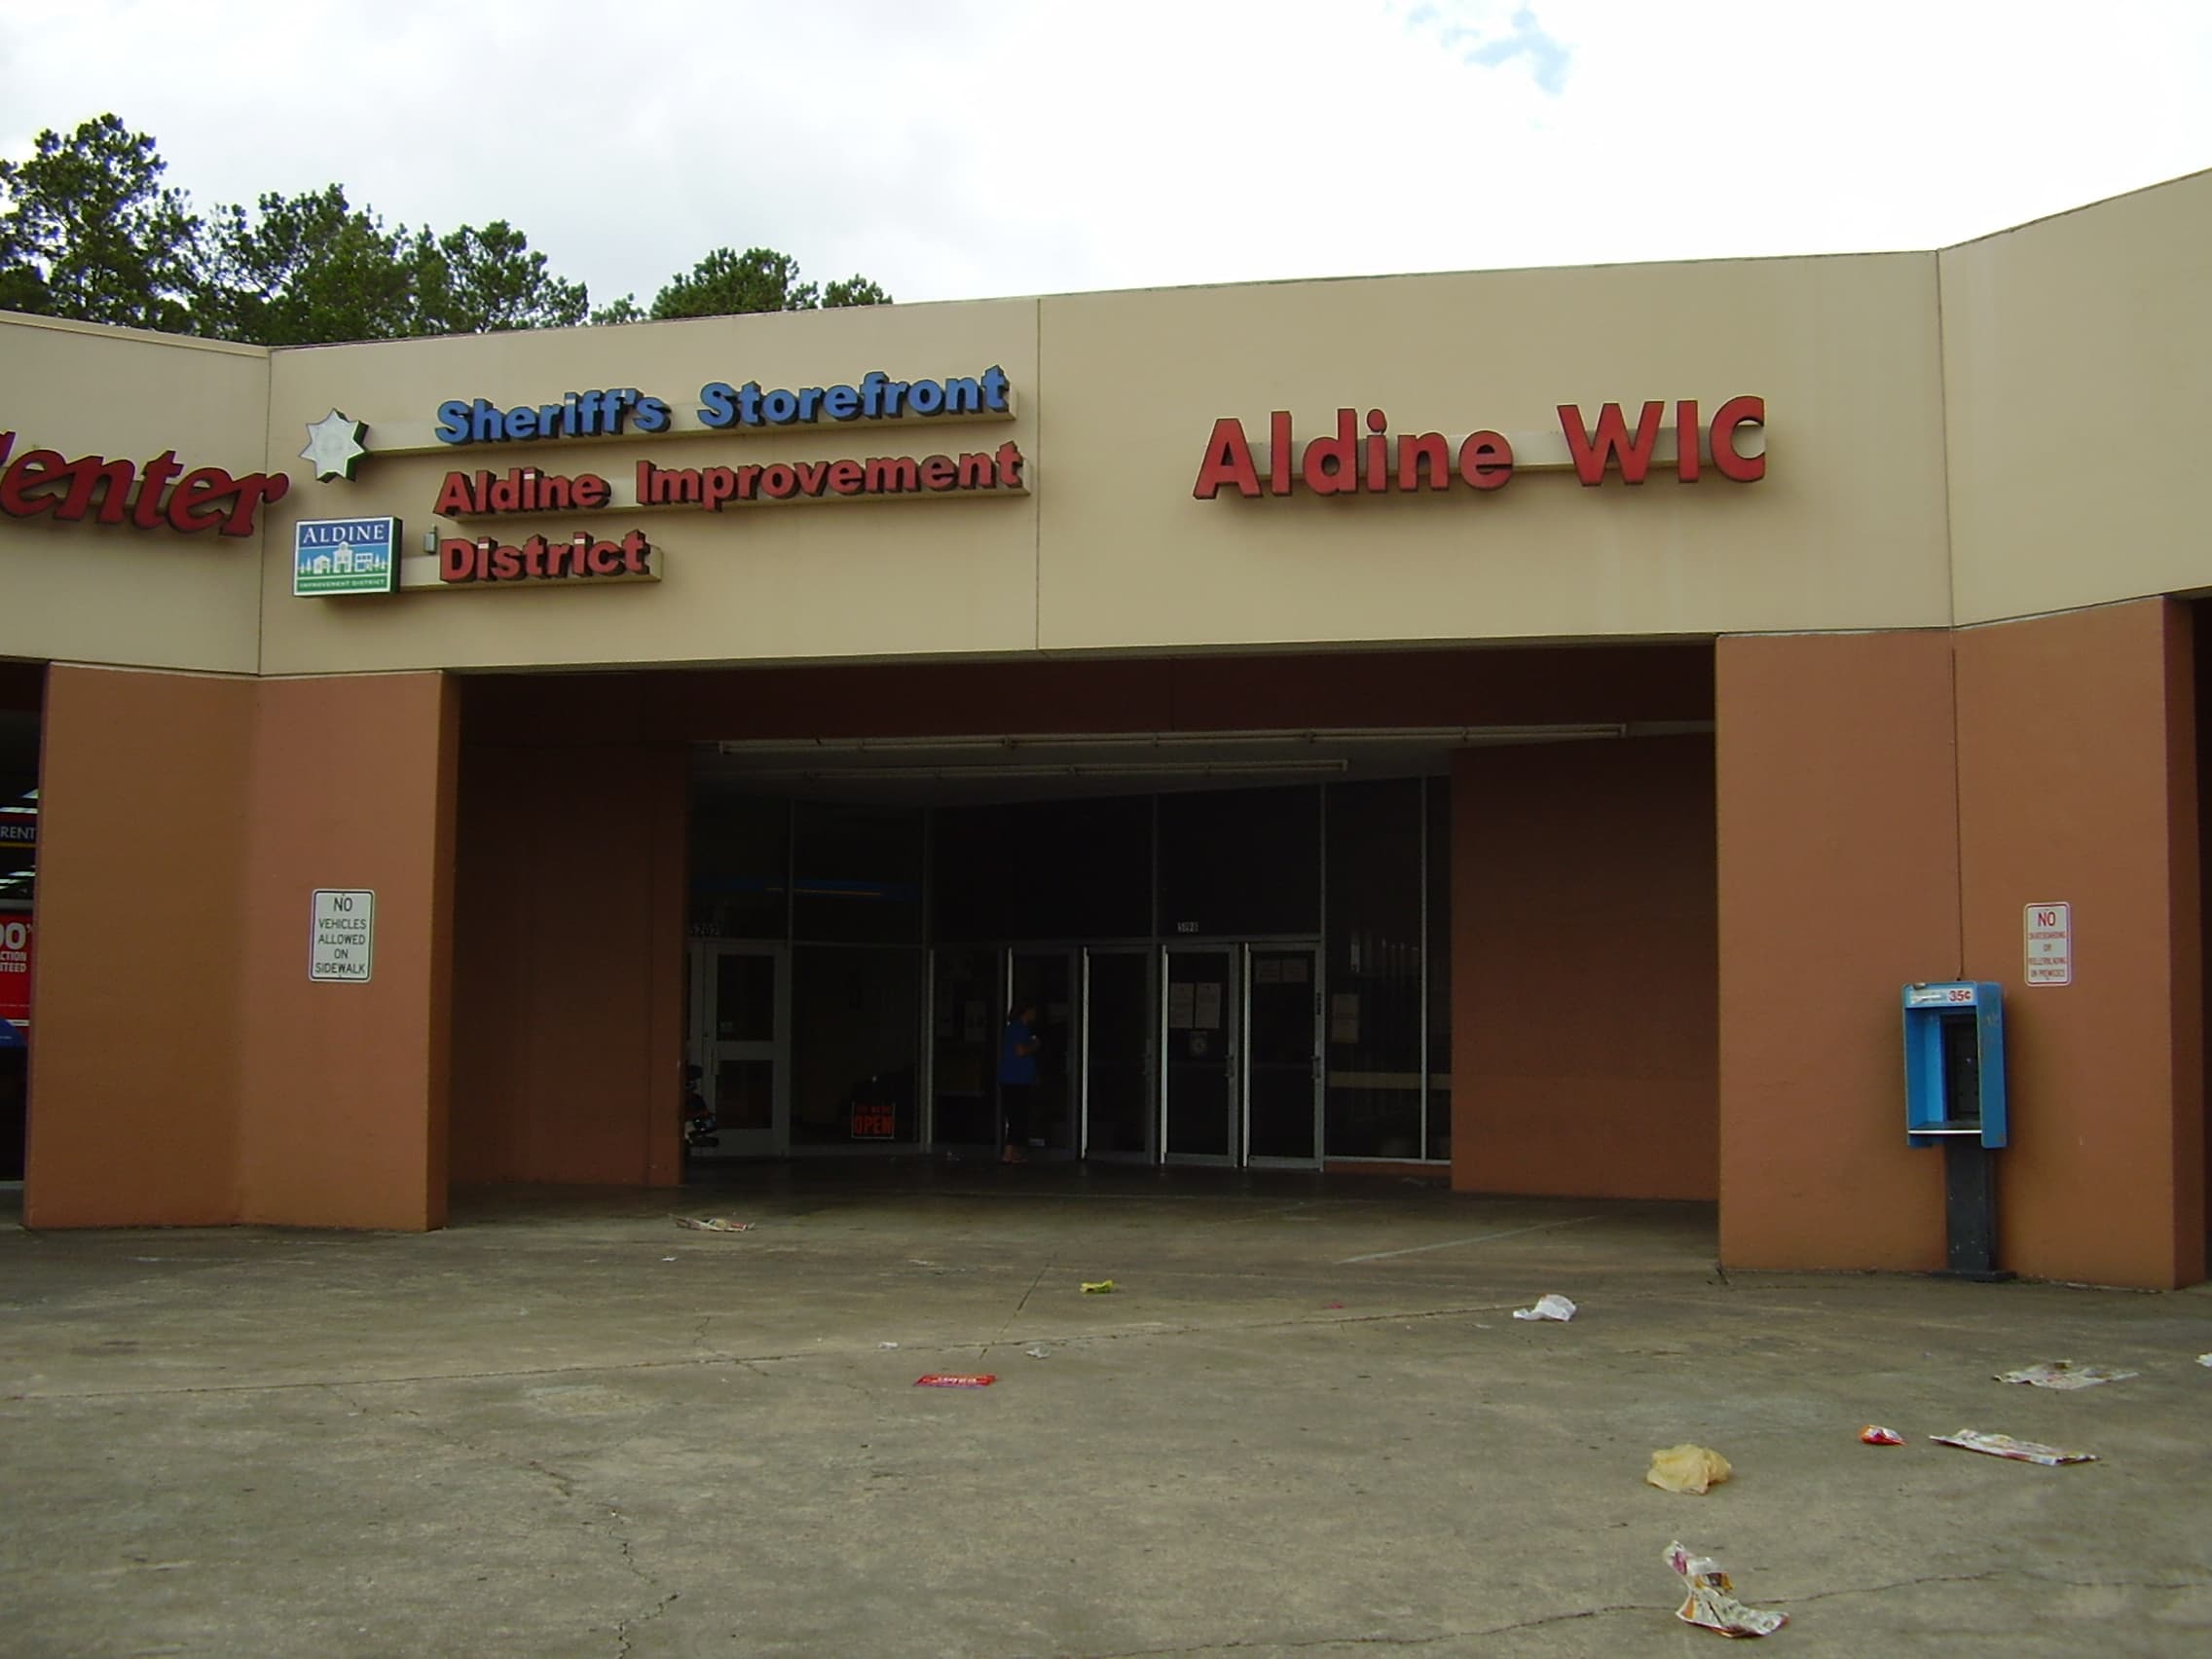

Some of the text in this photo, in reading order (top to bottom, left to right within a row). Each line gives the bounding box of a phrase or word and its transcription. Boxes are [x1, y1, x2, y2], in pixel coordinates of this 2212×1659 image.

[435, 364, 1011, 445] Sheriff's Storefront
[1193, 394, 1766, 499] Aldine WIC
[0, 430, 289, 538] enter
[434, 440, 1024, 516] Aldine Improvement
[303, 524, 385, 544] ALDINE
[440, 530, 651, 583] District
[334, 897, 353, 912] NO
[318, 918, 367, 930] VEHICLES
[2038, 911, 2056, 927] NO
[318, 934, 366, 945] ALLOWED
[334, 948, 349, 959] ON
[314, 962, 366, 975] SIDEWALK
